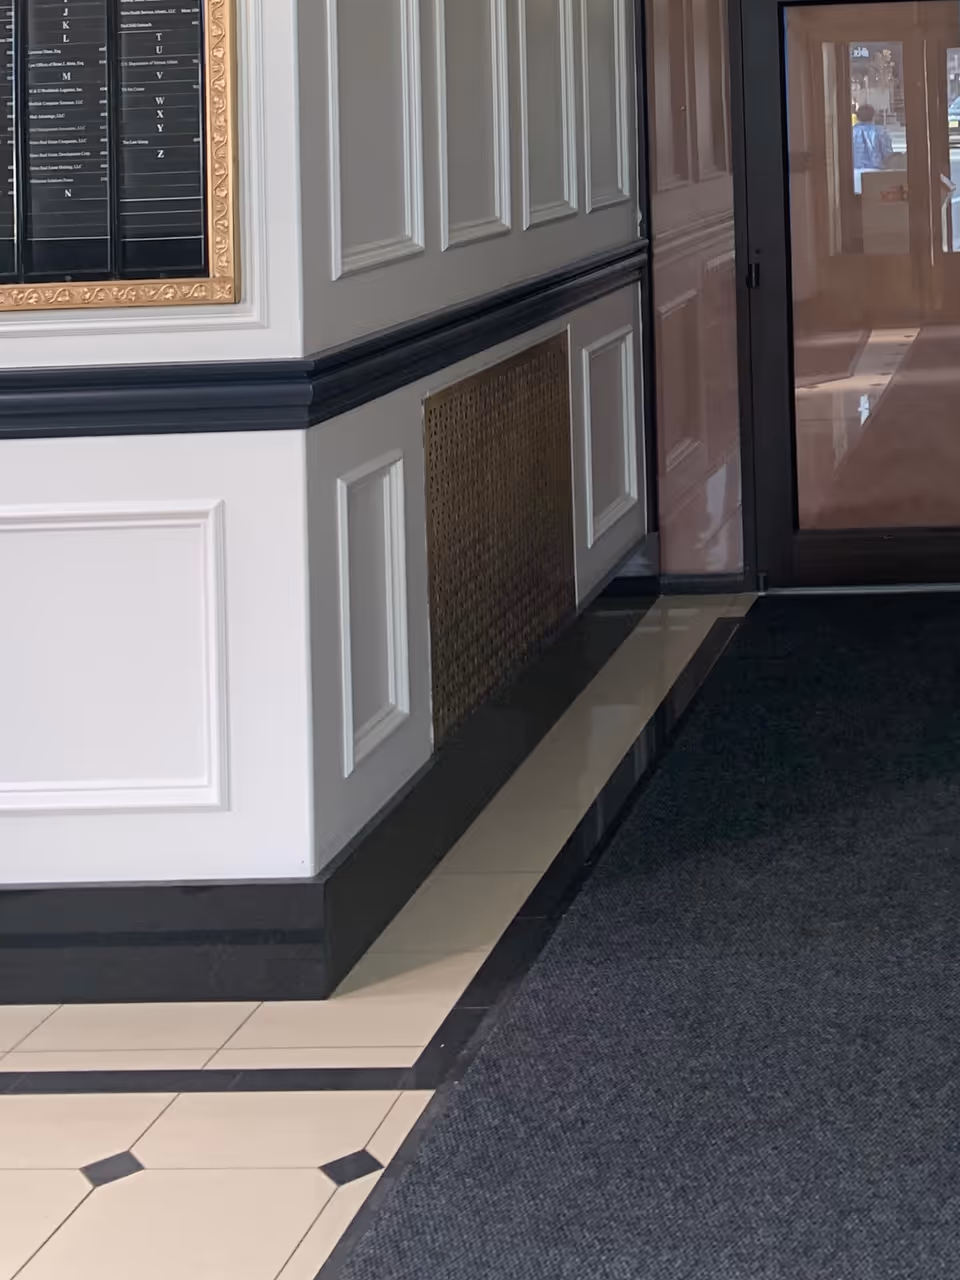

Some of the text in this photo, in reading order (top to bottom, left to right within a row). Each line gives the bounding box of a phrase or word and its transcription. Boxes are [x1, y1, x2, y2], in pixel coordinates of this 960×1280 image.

[63, 8, 68, 16] J
[62, 21, 70, 29] K
[63, 34, 70, 43] L
[156, 33, 162, 41] T
[156, 46, 163, 54] U
[62, 72, 71, 81] M
[155, 97, 165, 105] W
[156, 110, 164, 118] X
[157, 124, 164, 132] Y
[157, 150, 165, 158] Z
[65, 189, 72, 198] N
